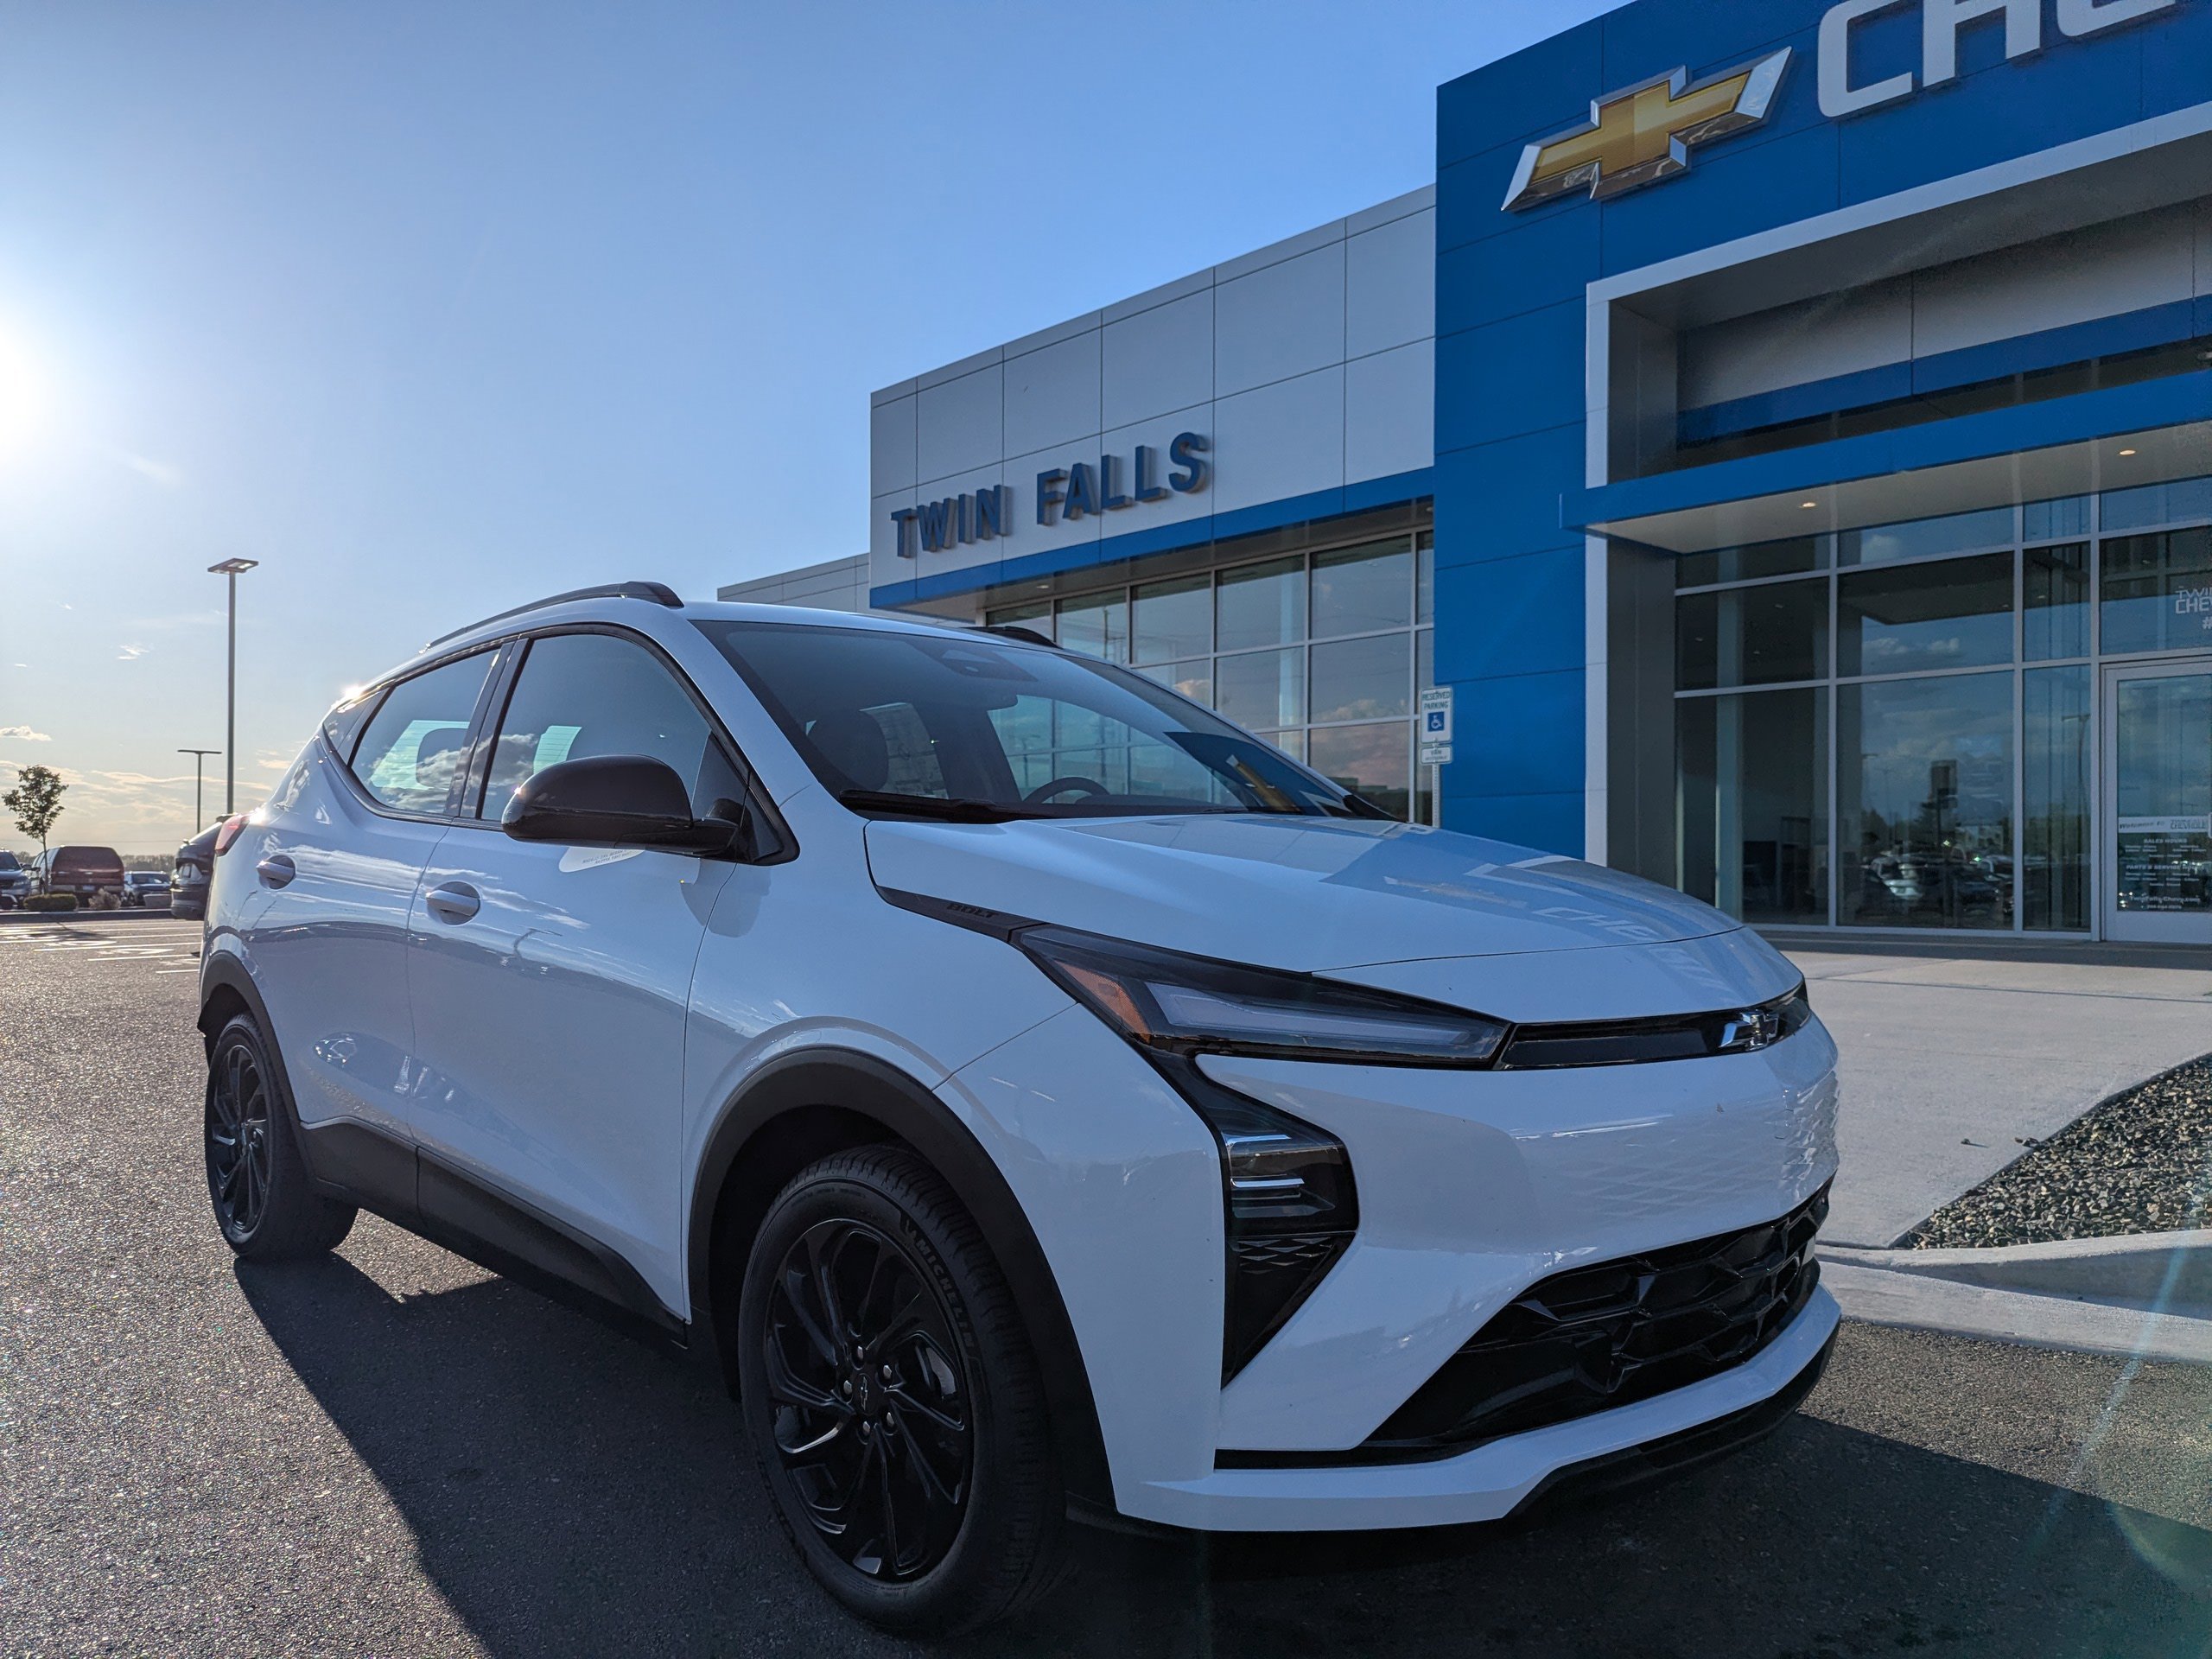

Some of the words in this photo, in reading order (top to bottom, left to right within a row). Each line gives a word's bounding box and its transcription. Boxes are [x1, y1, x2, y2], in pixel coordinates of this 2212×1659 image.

[891, 484, 1008, 559] TWIN
[1037, 431, 1208, 527] FALLS
[1422, 692, 1451, 701] RESERVED
[946, 903, 1000, 918] BOLT
[915, 1237, 976, 1348] MICHELIN
